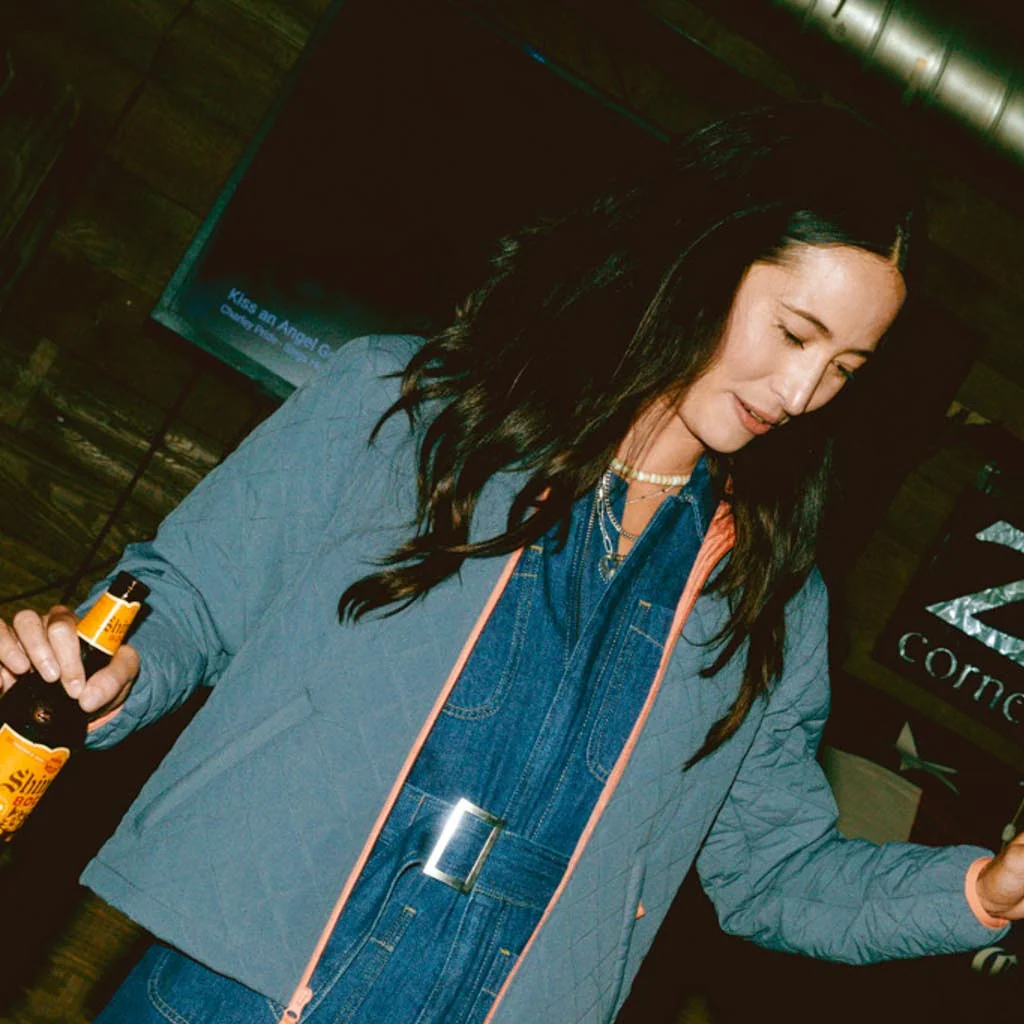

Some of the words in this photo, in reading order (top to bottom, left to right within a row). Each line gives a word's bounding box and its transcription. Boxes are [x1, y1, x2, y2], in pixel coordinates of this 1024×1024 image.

[228, 288, 258, 314] Kiss
[258, 310, 277, 328] an
[276, 320, 319, 352] Angel
